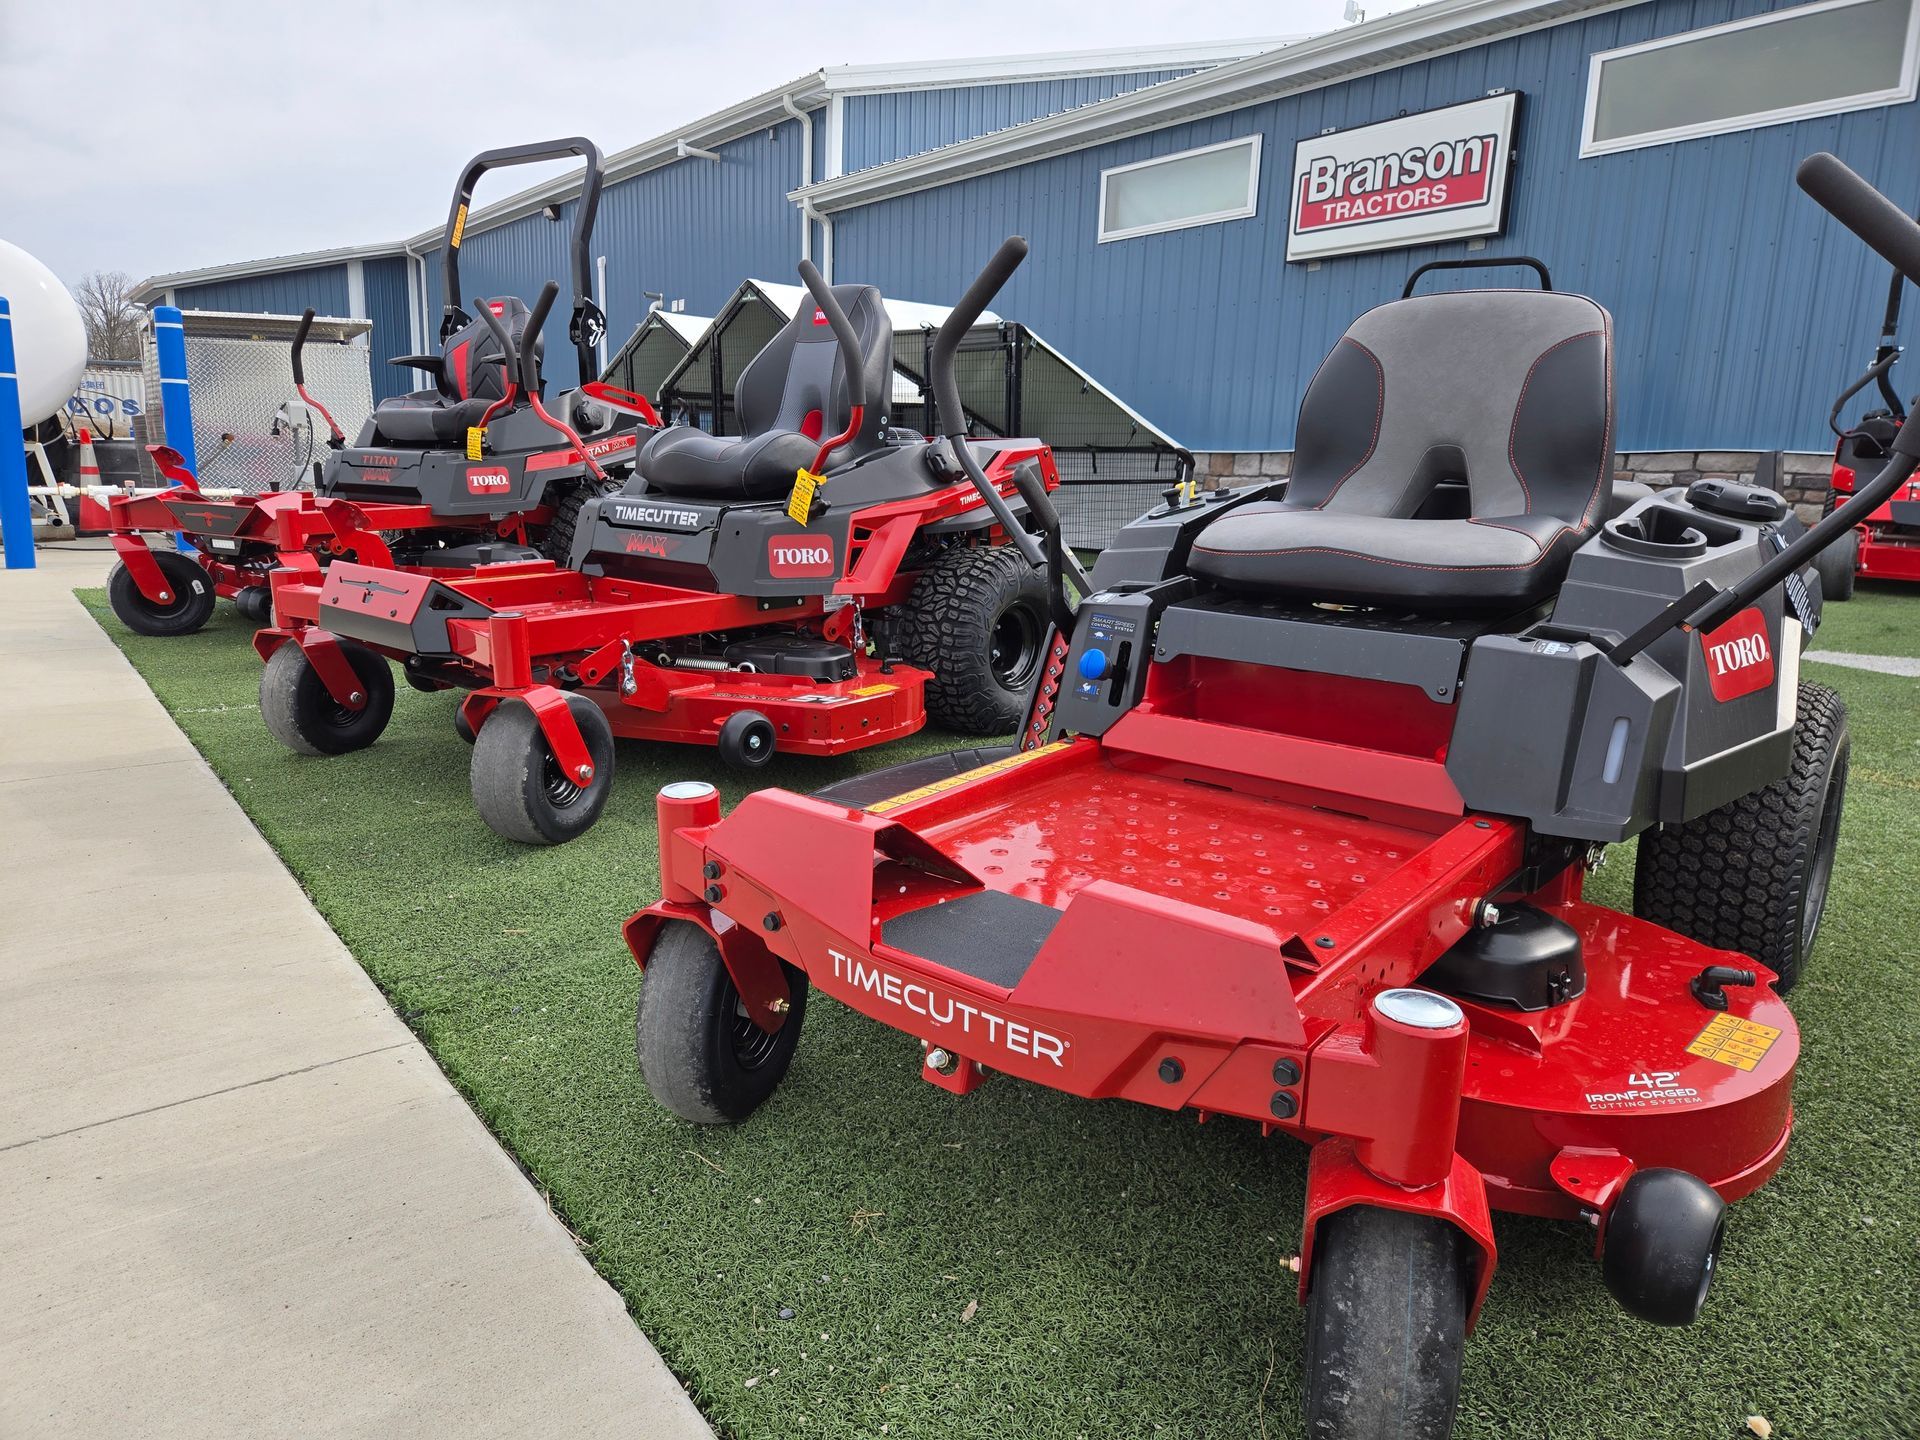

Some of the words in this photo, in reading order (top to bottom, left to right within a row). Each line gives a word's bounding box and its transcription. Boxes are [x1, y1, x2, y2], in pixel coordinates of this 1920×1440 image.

[1307, 135, 1485, 203] Branson
[1322, 184, 1448, 222] TRACTORS
[362, 454, 398, 466] TITAN
[469, 473, 508, 487] TORO
[615, 505, 699, 527] TIMECUTTER
[625, 532, 668, 557] MAX
[773, 548, 829, 565] TORO
[1709, 632, 1767, 677] TORO
[828, 948, 1064, 1068] TIMECUTTER
[1589, 1100, 1646, 1110] CUTTING
[1650, 1096, 1703, 1106] SYSTEM
